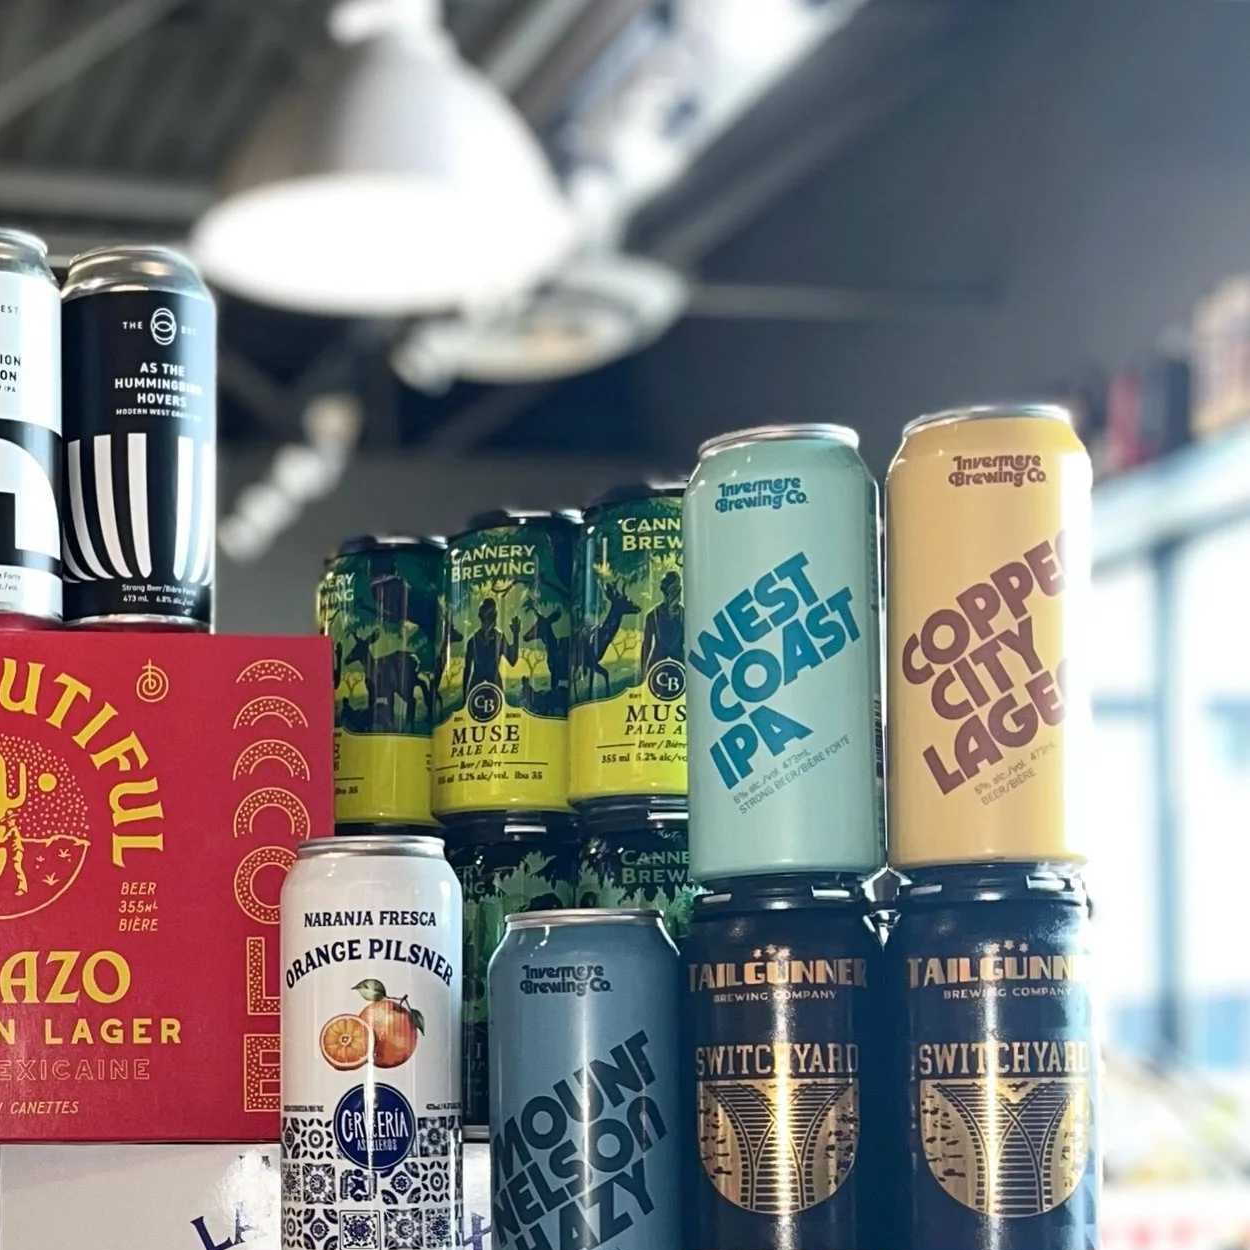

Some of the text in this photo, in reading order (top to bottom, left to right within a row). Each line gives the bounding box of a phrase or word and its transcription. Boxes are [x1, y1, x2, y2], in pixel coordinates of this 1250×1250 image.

[140, 362, 186, 377] AS THE
[137, 392, 187, 408] HOVERS
[952, 454, 1041, 477] Invermere
[718, 476, 802, 499] Invermere
[714, 492, 785, 514] Brewing
[451, 544, 536, 565] CANNERY
[451, 558, 536, 583] BREWING
[688, 551, 820, 680] WEST
[709, 587, 862, 723] COAST
[931, 616, 1043, 721] CITY
[451, 724, 520, 744] MUSE
[451, 742, 519, 758] PALE ALE
[709, 704, 814, 791] IPA
[120, 882, 157, 895] BEER
[118, 916, 159, 932] BIÈRE
[304, 911, 436, 927] NARANJA FRESCA
[286, 938, 454, 990] ORANGE PILSNER
[689, 956, 868, 989] TAILGUNNER
[713, 991, 770, 1002] BREWING
[45, 1016, 183, 1045] LAGER
[695, 1043, 860, 1076] SWITCHYARD
[918, 1041, 1090, 1075] SWITCHYARD
[10, 1101, 79, 1115] CANETTES
[493, 1029, 656, 1190] MOUNT
[492, 1096, 668, 1248] NELSON
